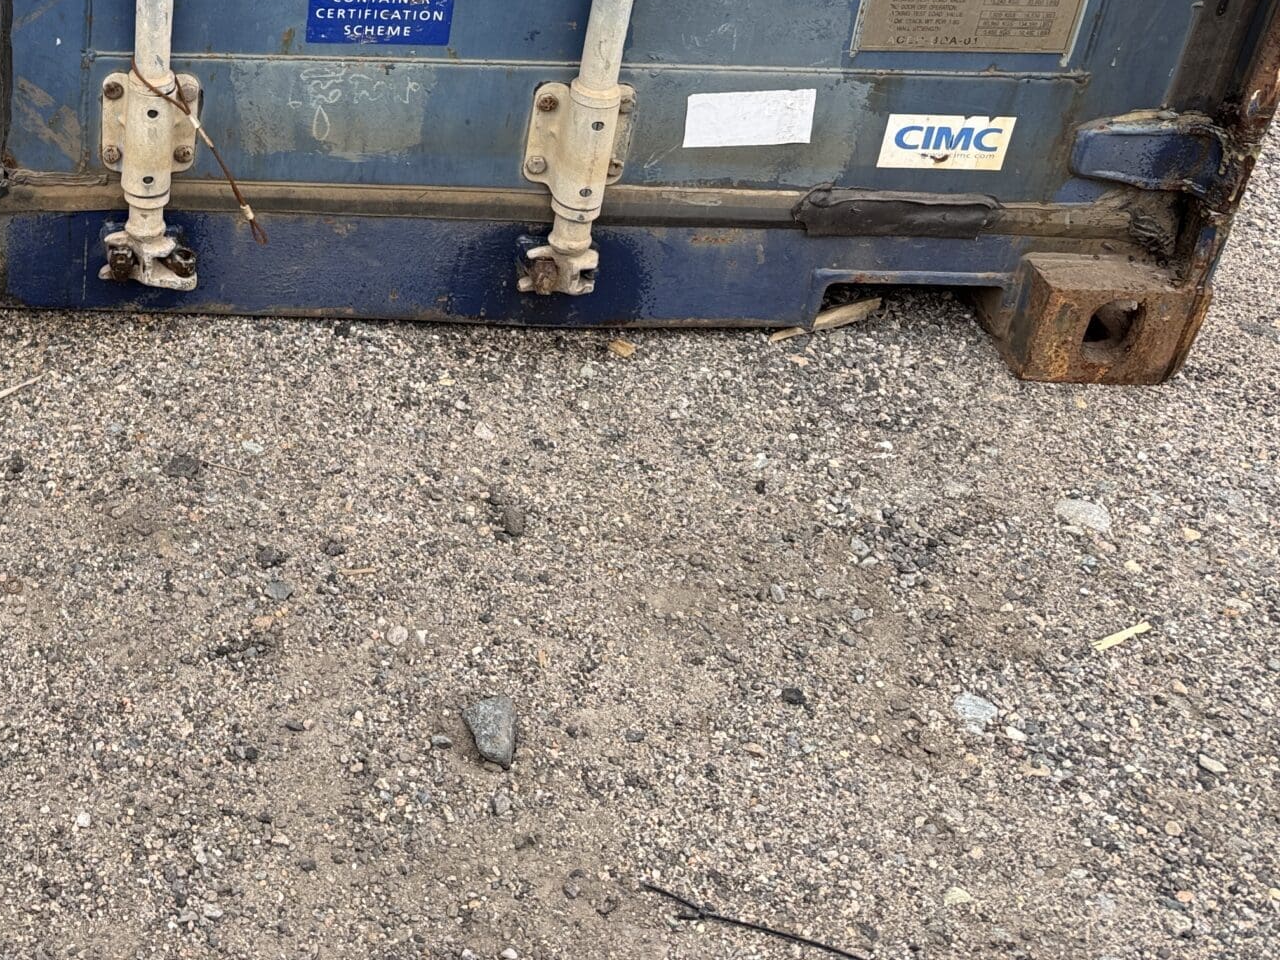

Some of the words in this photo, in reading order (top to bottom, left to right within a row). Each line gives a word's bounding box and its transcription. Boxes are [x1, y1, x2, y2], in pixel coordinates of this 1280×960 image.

[316, 8, 444, 22] CERTIFICATION
[344, 25, 411, 37] SCHEME
[894, 125, 1003, 152] CIMC
